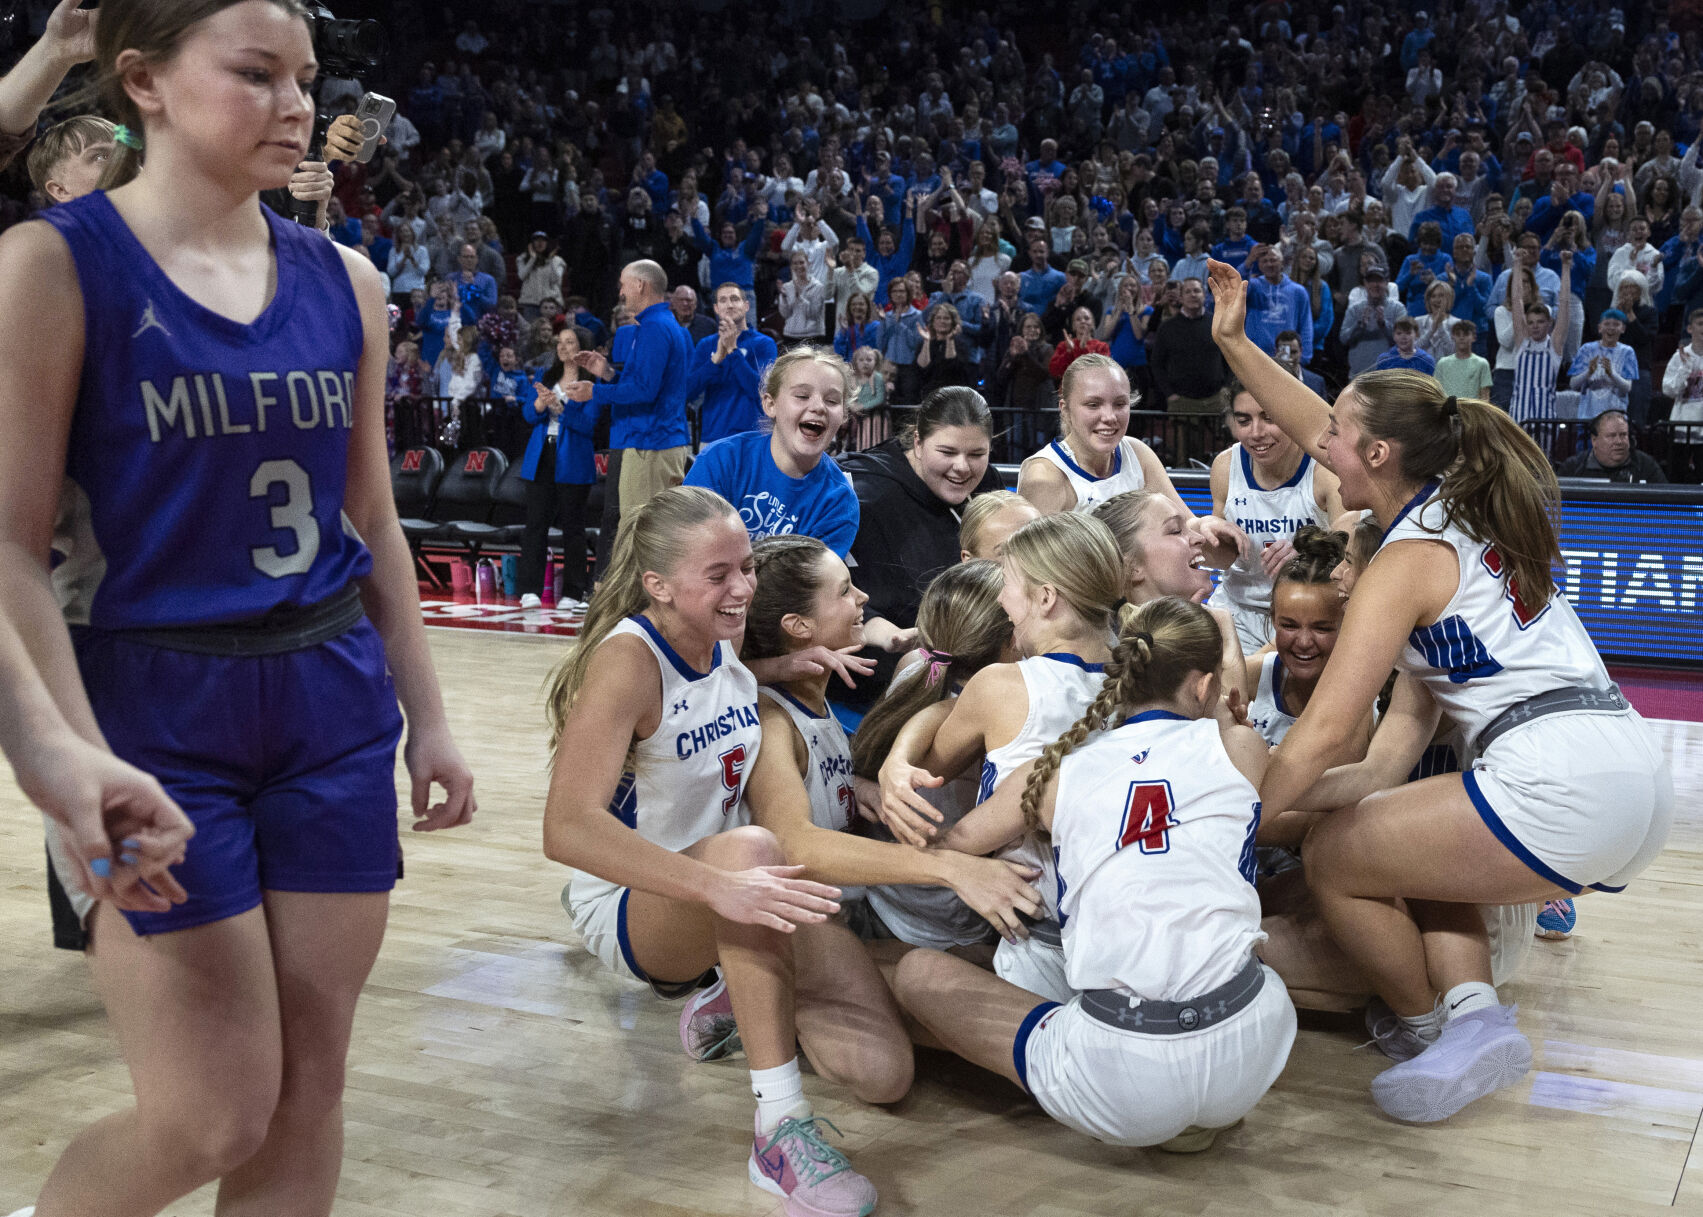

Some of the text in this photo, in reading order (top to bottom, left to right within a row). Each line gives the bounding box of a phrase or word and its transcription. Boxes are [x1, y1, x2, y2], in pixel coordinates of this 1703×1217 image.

[401, 450, 424, 471] N
[464, 451, 488, 472] N
[249, 459, 320, 578] 3
[717, 743, 747, 816] 5
[1115, 779, 1180, 855] 4
